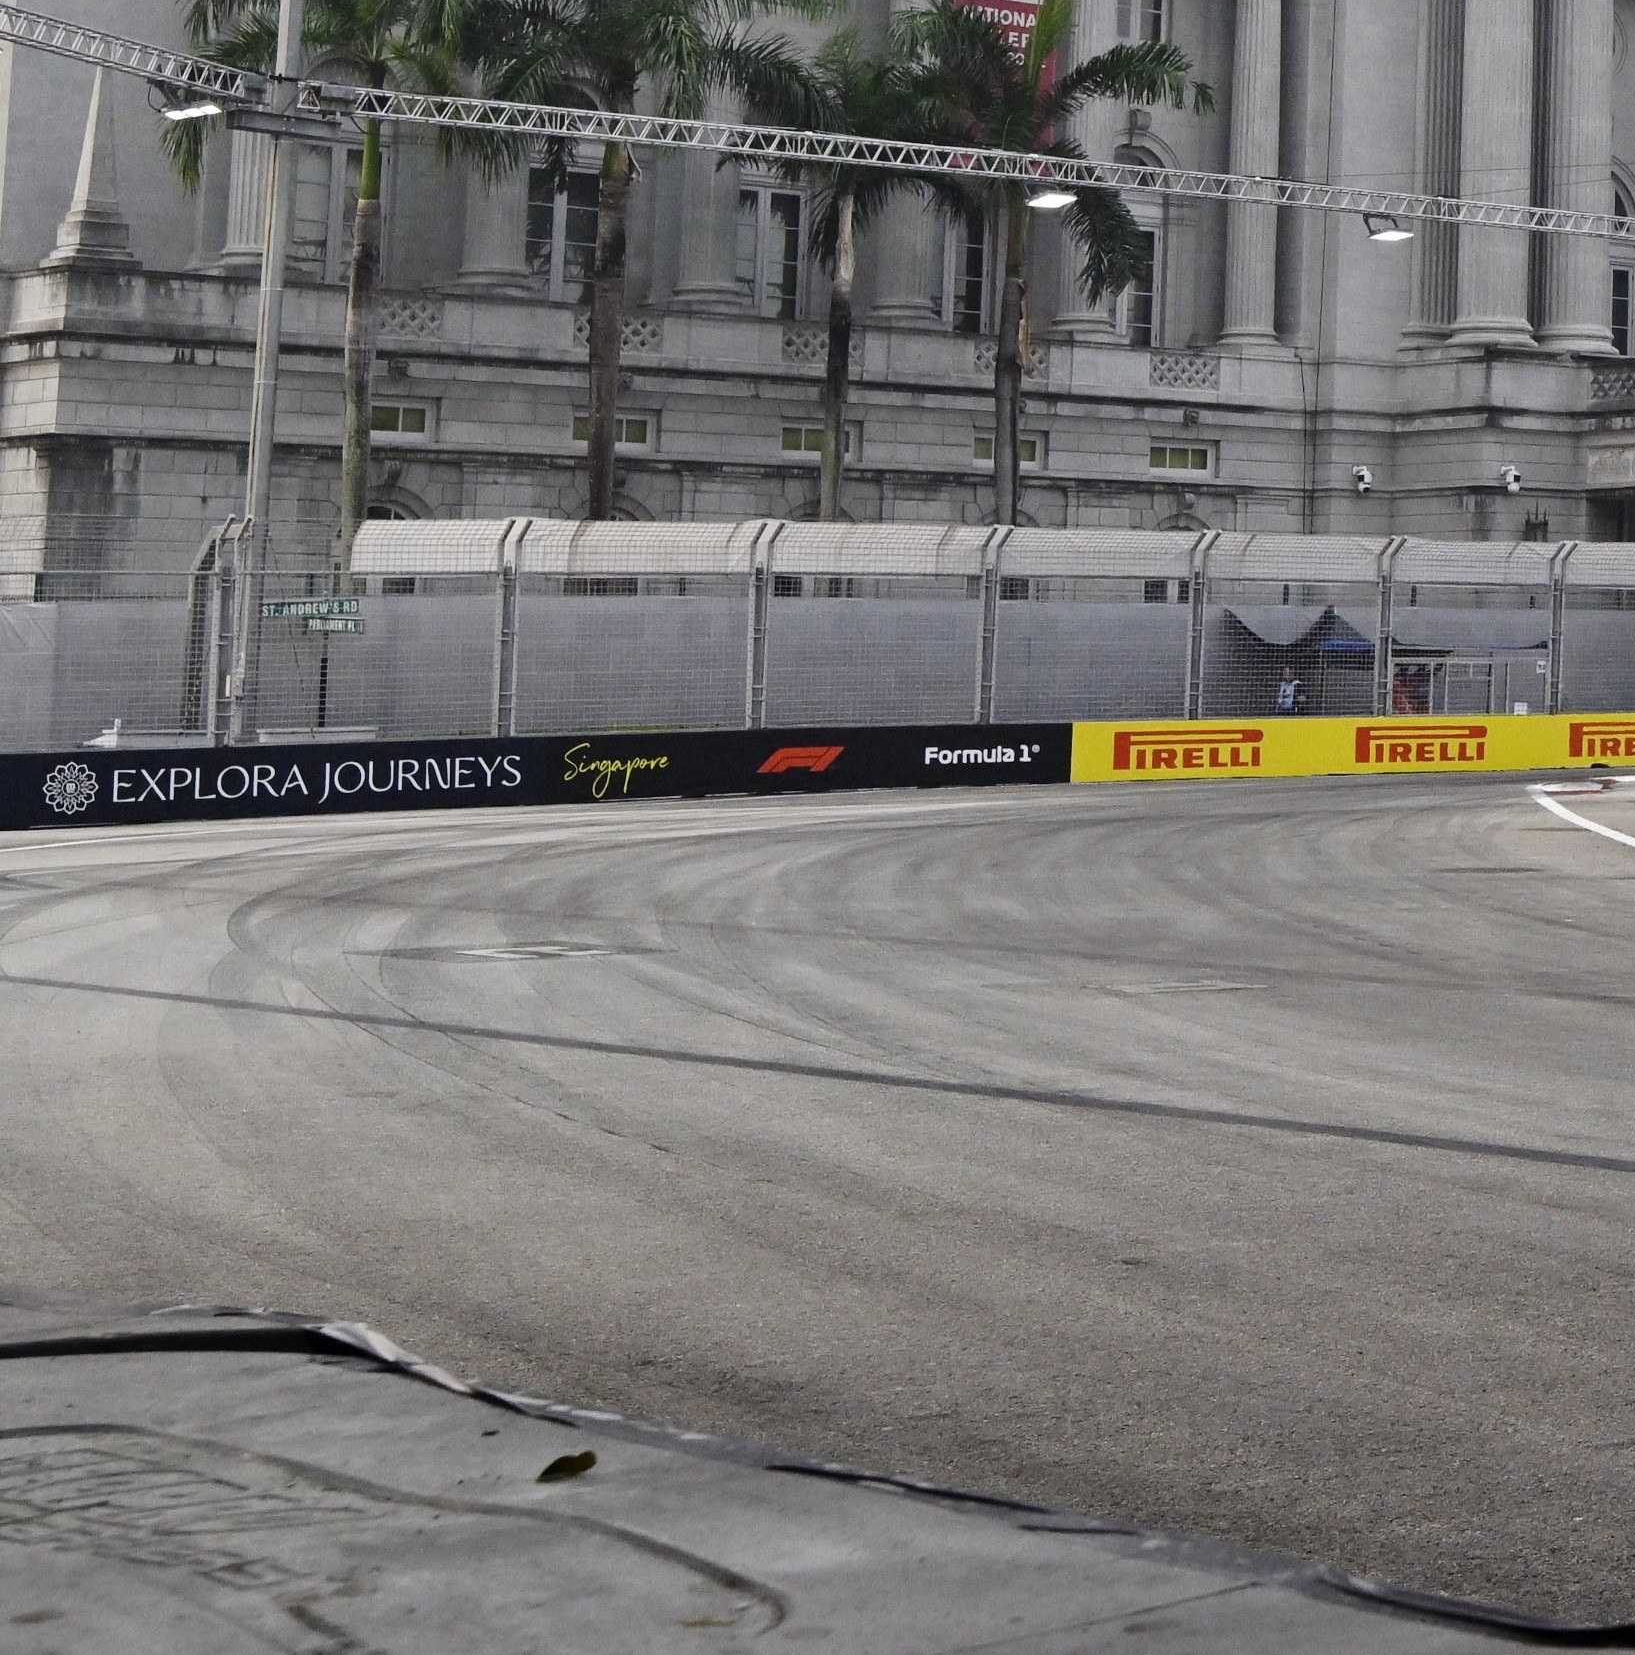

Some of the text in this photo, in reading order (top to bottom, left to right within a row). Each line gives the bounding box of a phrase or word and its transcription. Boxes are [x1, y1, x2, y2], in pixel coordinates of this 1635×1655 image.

[262, 600, 358, 617] ST. ANDREW'S RD
[925, 745, 1015, 765] Formula
[1113, 729, 1264, 770] PIRELLI
[1356, 725, 1487, 764] PIRELLI
[112, 755, 521, 804] EXPLORA JOURNEYS
[564, 743, 668, 797] Singapore
